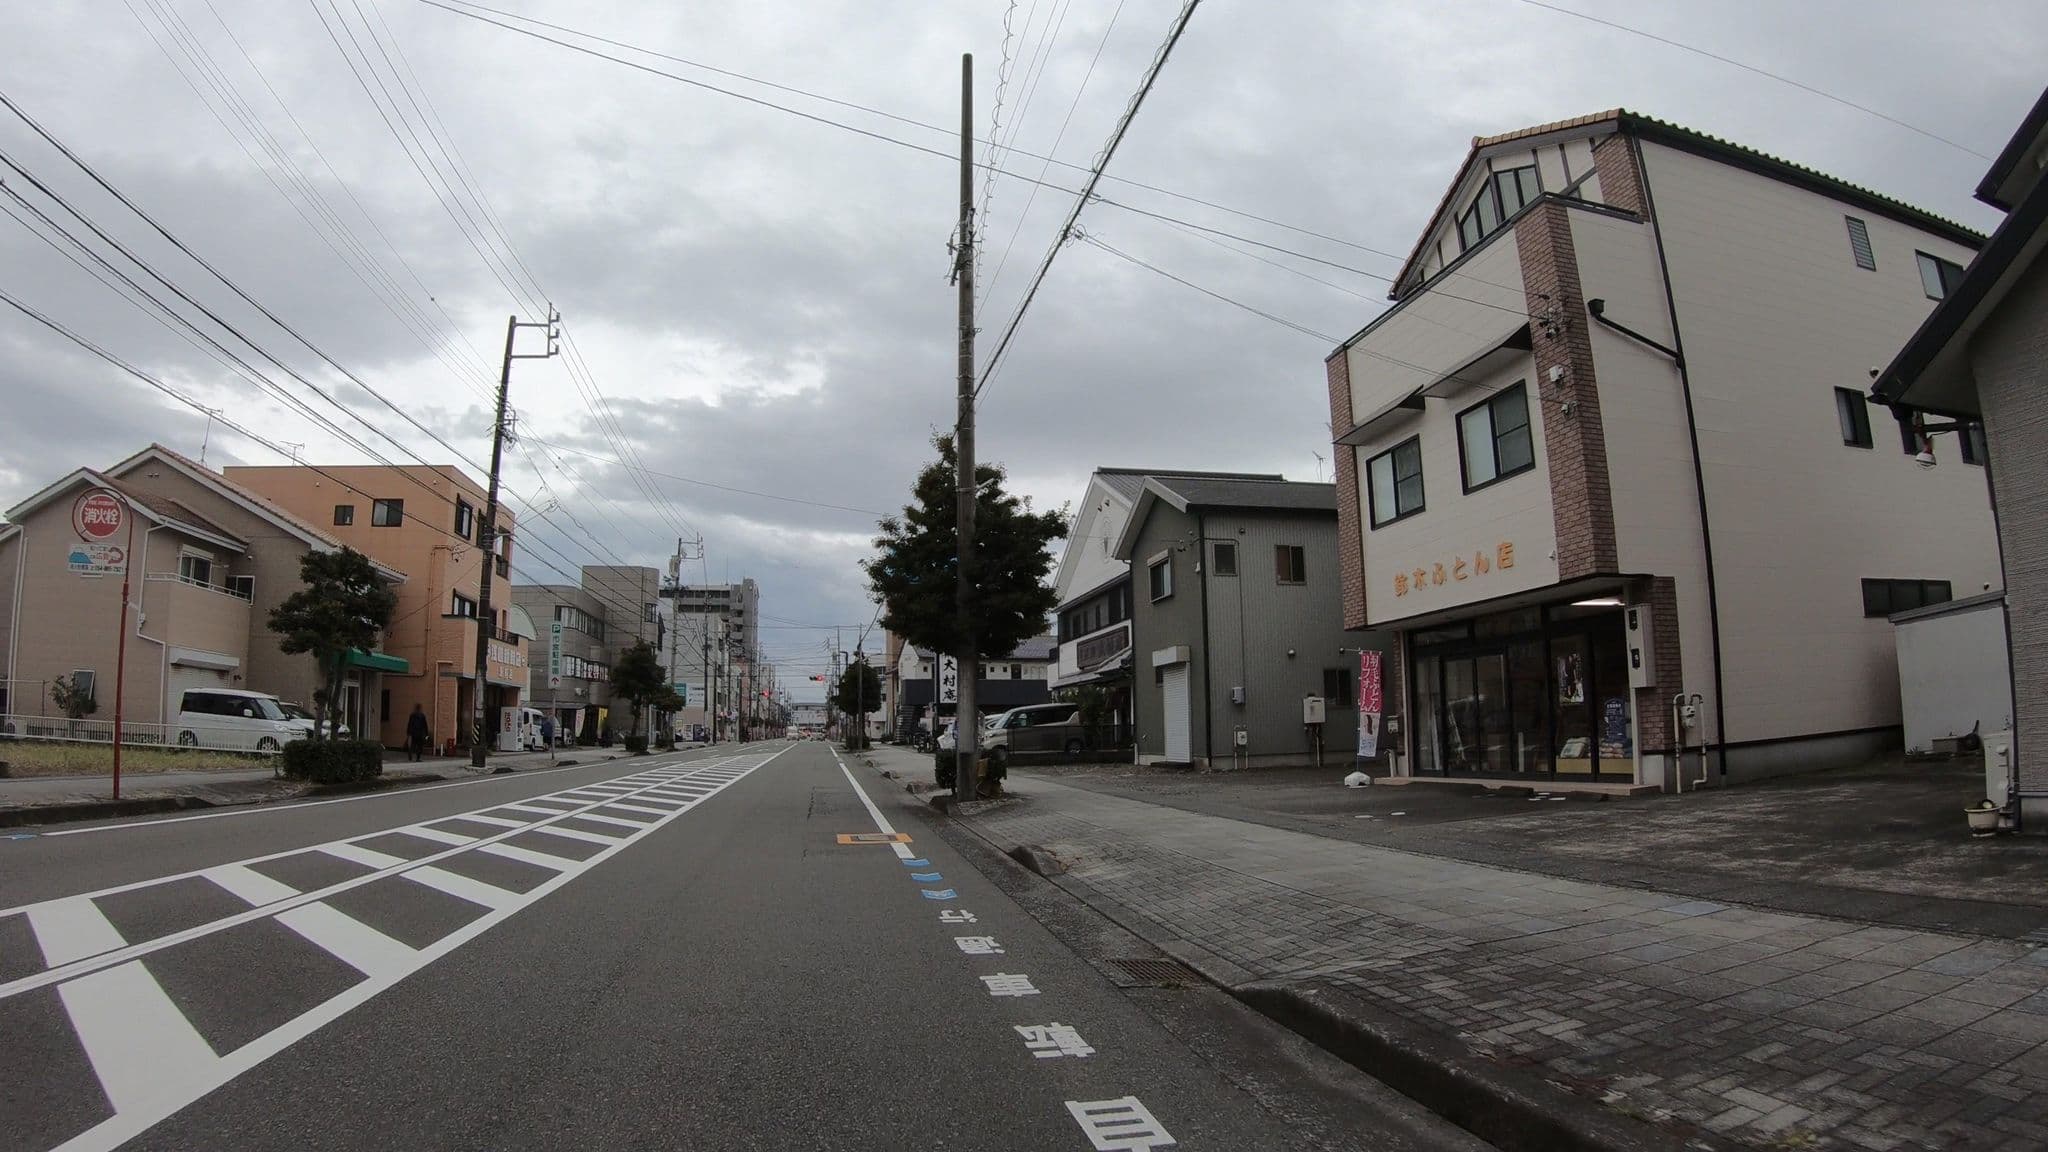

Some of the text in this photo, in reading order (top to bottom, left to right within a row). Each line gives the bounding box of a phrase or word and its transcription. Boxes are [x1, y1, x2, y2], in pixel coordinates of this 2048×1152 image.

[84, 507, 118, 525] 消火栓
[1393, 541, 1514, 598] 鈴木ふとん店
[942, 659, 957, 702] 大村庵
[1360, 655, 1371, 712] リフォーム
